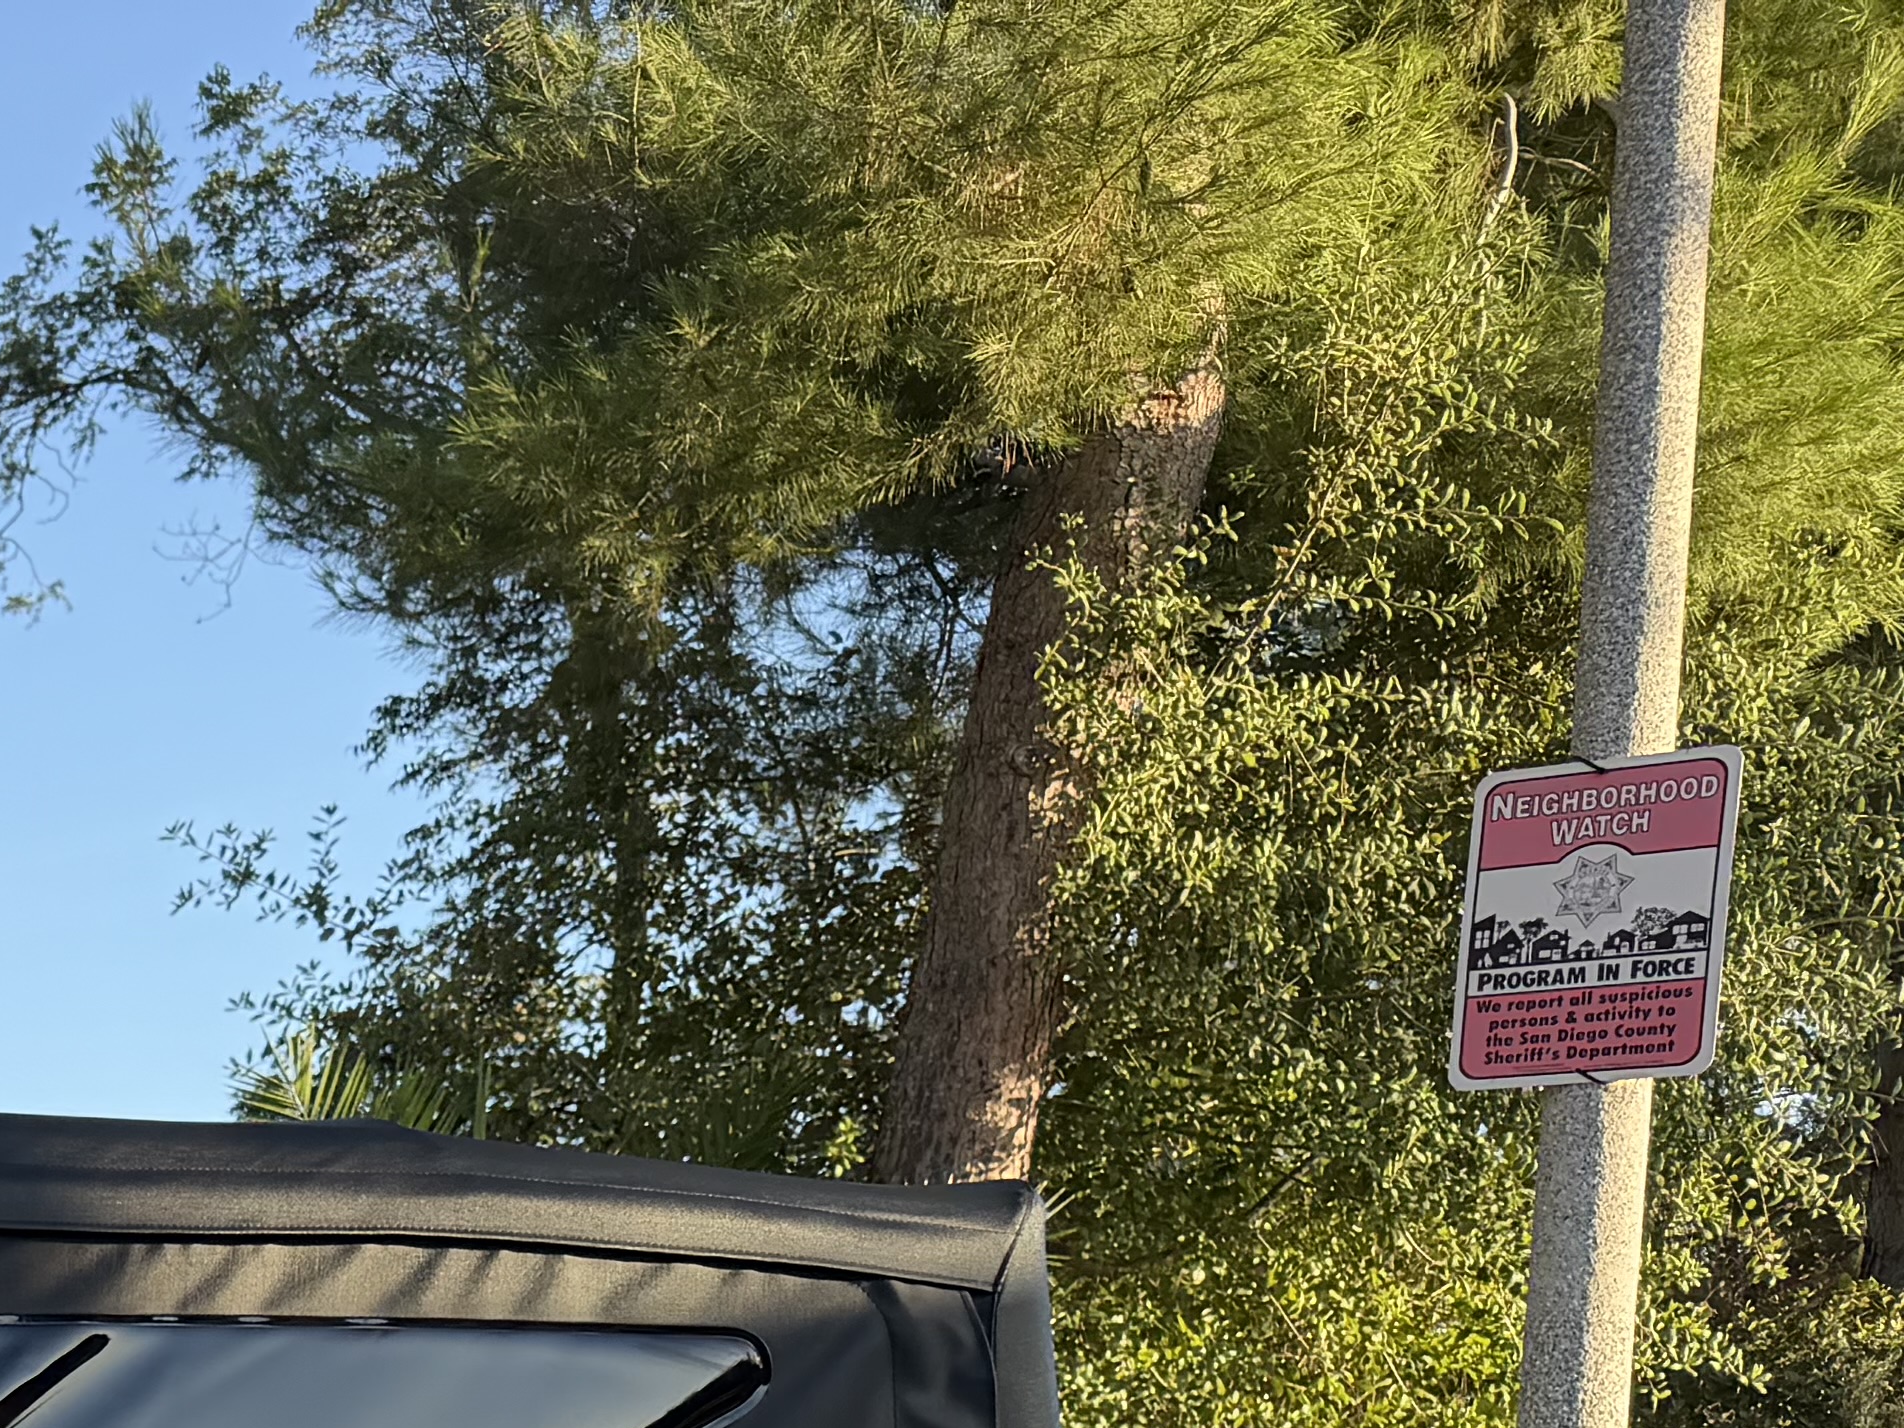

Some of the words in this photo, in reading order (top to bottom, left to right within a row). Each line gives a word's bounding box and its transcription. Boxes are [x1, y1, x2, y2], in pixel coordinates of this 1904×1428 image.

[1491, 775, 1719, 821] NEIGHBORHOOD
[1551, 810, 1651, 846] WATCH
[1477, 966, 1586, 992] PROGRAM
[1597, 963, 1620, 982] IN
[1630, 957, 1695, 979] FORCE
[1477, 1000, 1504, 1013] We
[1507, 995, 1564, 1011] report
[1569, 991, 1592, 1006] all
[1599, 986, 1693, 1004] suspicious
[1488, 1015, 1559, 1032] persons
[1565, 1011, 1578, 1024] &
[1584, 1006, 1652, 1022] activity
[1658, 1004, 1676, 1017] to
[1486, 1033, 1513, 1047] the
[1519, 1031, 1551, 1046] San
[1557, 1027, 1608, 1043] Diego
[1614, 1022, 1677, 1038] County
[1484, 1046, 1560, 1065] Sheriff's
[1566, 1039, 1675, 1061] Department
